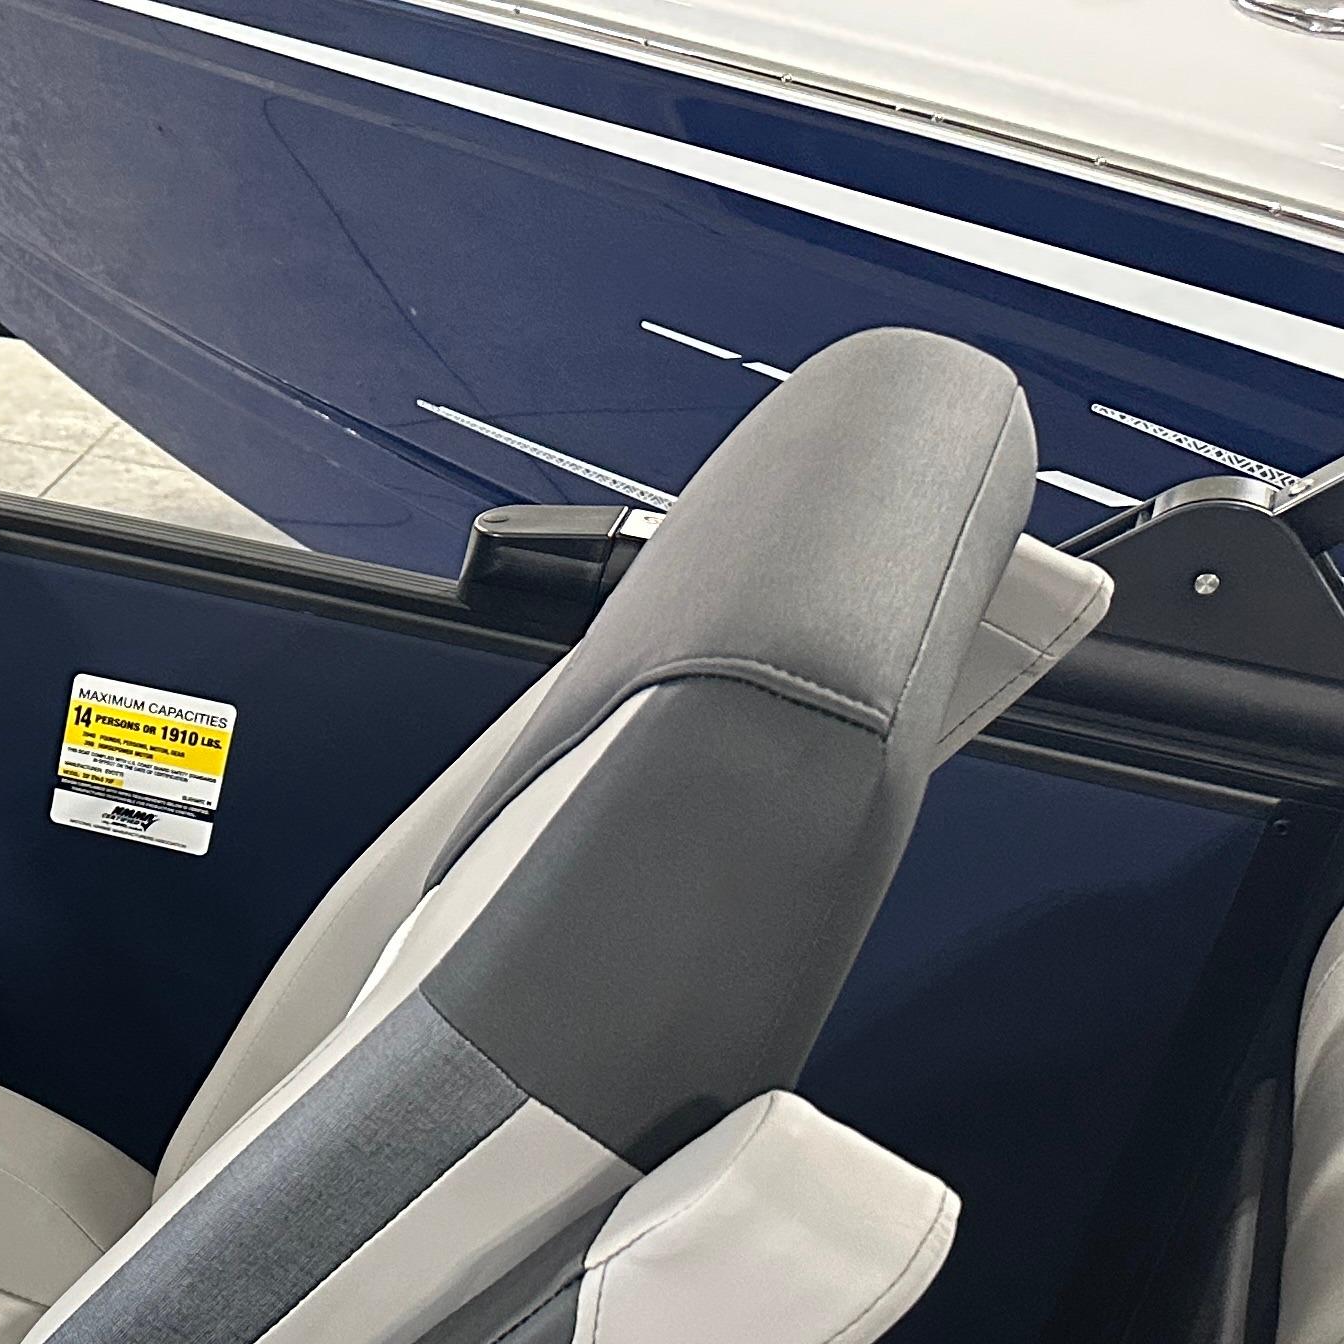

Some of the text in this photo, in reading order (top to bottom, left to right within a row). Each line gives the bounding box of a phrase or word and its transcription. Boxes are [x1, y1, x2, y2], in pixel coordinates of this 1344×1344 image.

[74, 704, 223, 750] 14 PERSONS OR 1910 LBS.
[78, 687, 229, 729] MAXIMUM CAPACITIES
